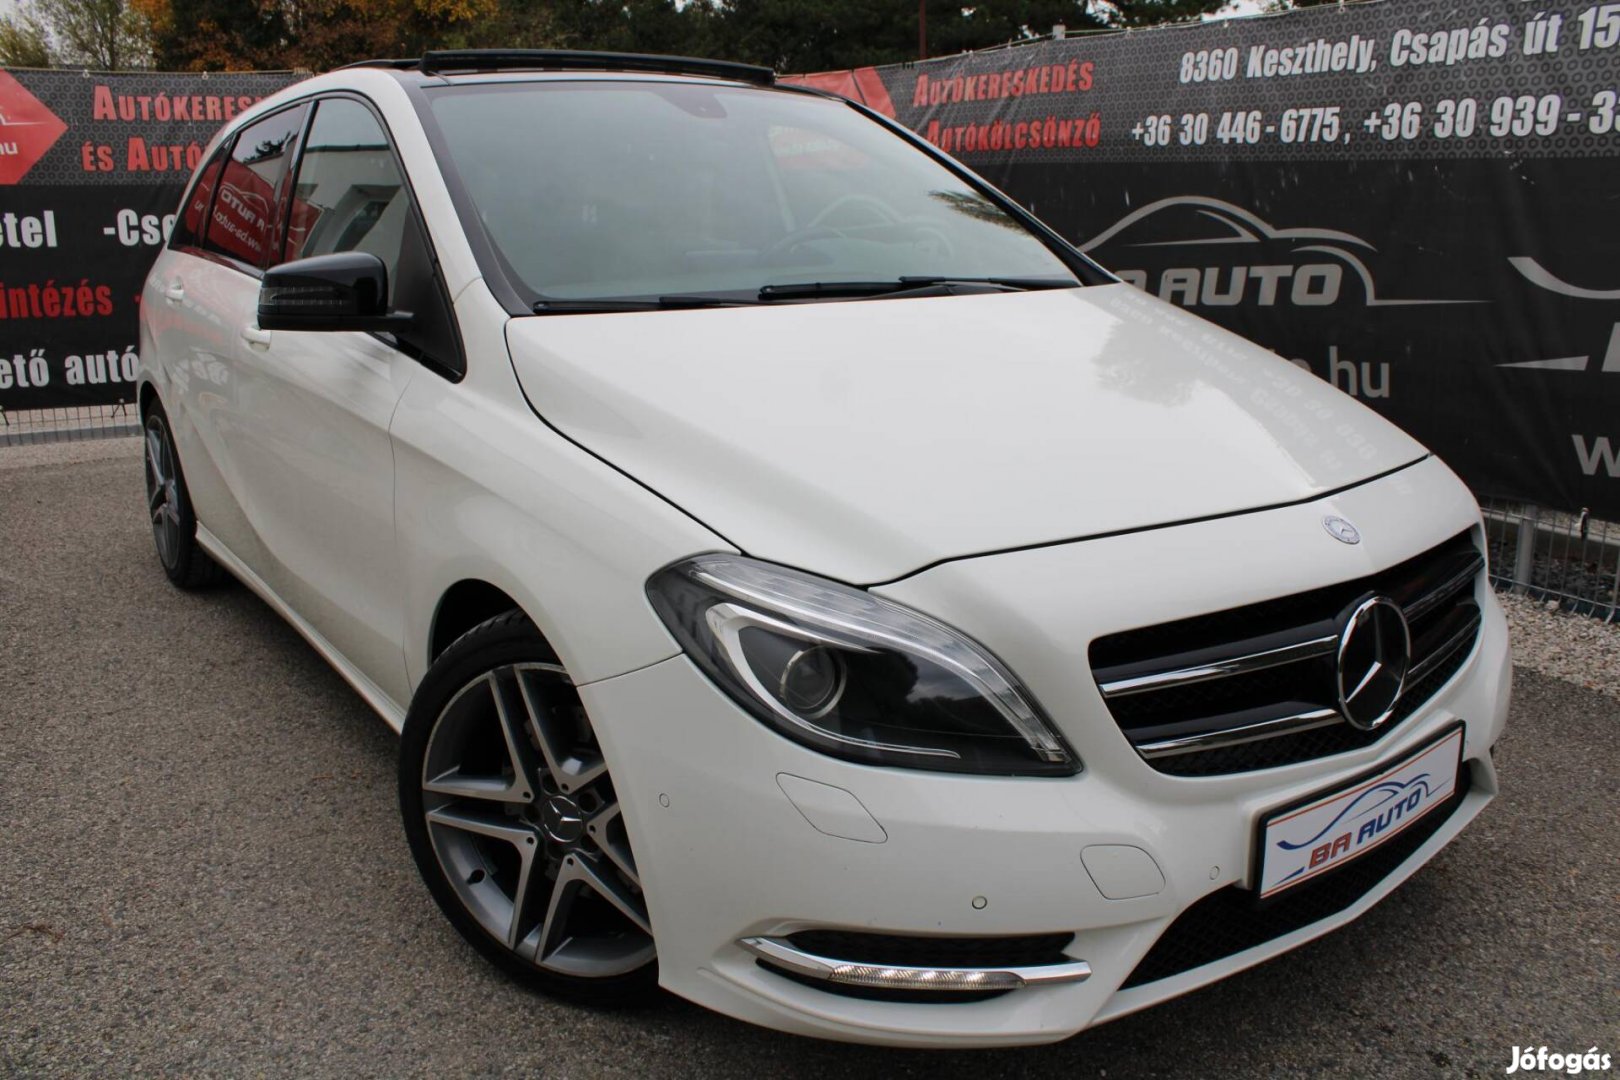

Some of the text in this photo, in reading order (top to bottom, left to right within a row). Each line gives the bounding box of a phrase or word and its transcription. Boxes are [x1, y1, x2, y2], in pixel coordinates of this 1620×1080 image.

[1179, 47, 1239, 83] 8360
[1246, 34, 1377, 78] Keszthely,
[1390, 17, 1510, 66] Csapás
[1523, 11, 1561, 55] út
[93, 84, 263, 122] AUTÓKERES
[1131, 115, 1171, 146] +36
[1179, 113, 1208, 146] 30
[1363, 101, 1422, 140] +36
[1434, 98, 1477, 138] 30
[82, 136, 207, 172] ÉS AUTÓ
[1309, 788, 1421, 869] BA AUTO
